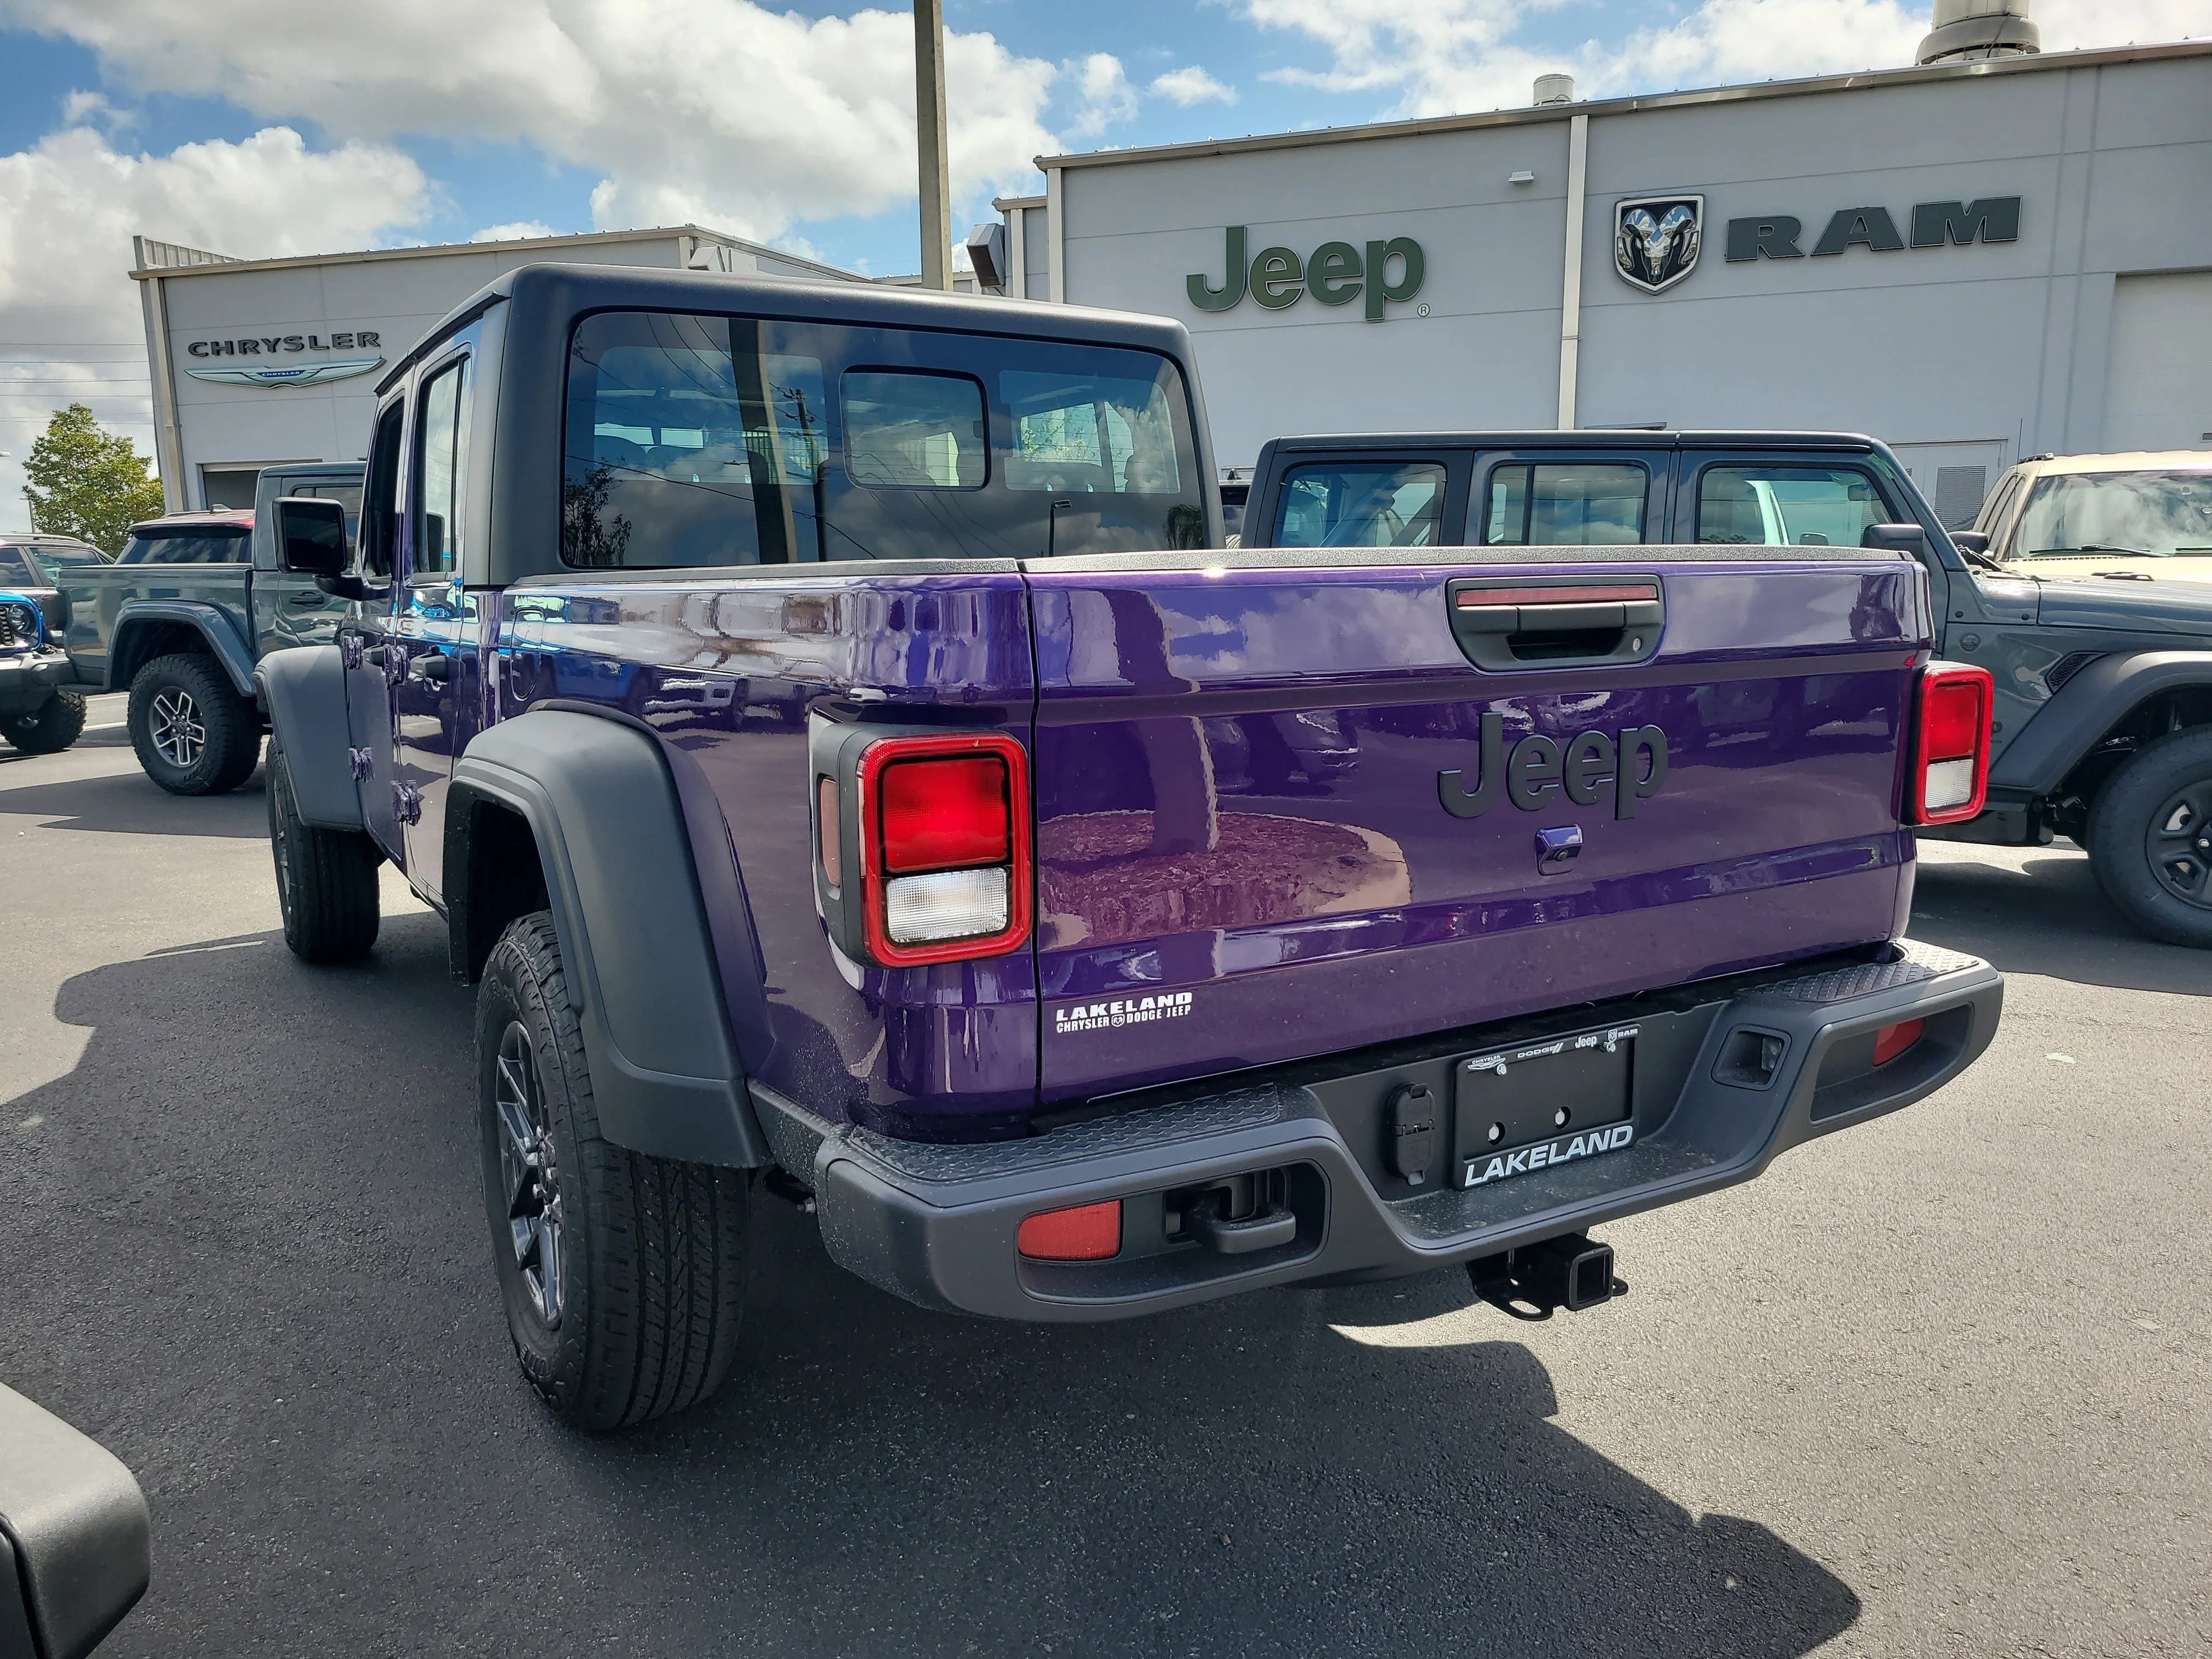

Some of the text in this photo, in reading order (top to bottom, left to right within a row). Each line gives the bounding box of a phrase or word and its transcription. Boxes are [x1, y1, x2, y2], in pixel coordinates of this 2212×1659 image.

[1725, 195, 2023, 262] RAM
[1186, 225, 1426, 323] Jeep
[188, 332, 380, 357] CHRYSLER
[1437, 711, 1668, 821] Jeep
[1056, 992, 1193, 1022] LAKELAND
[1056, 1005, 1191, 1034] CHRYSLER DODGE JEEP
[1471, 1028, 1638, 1064] CHRYSLER DODGE Jeep RAM
[1465, 1125, 1633, 1187] LAKELAND
